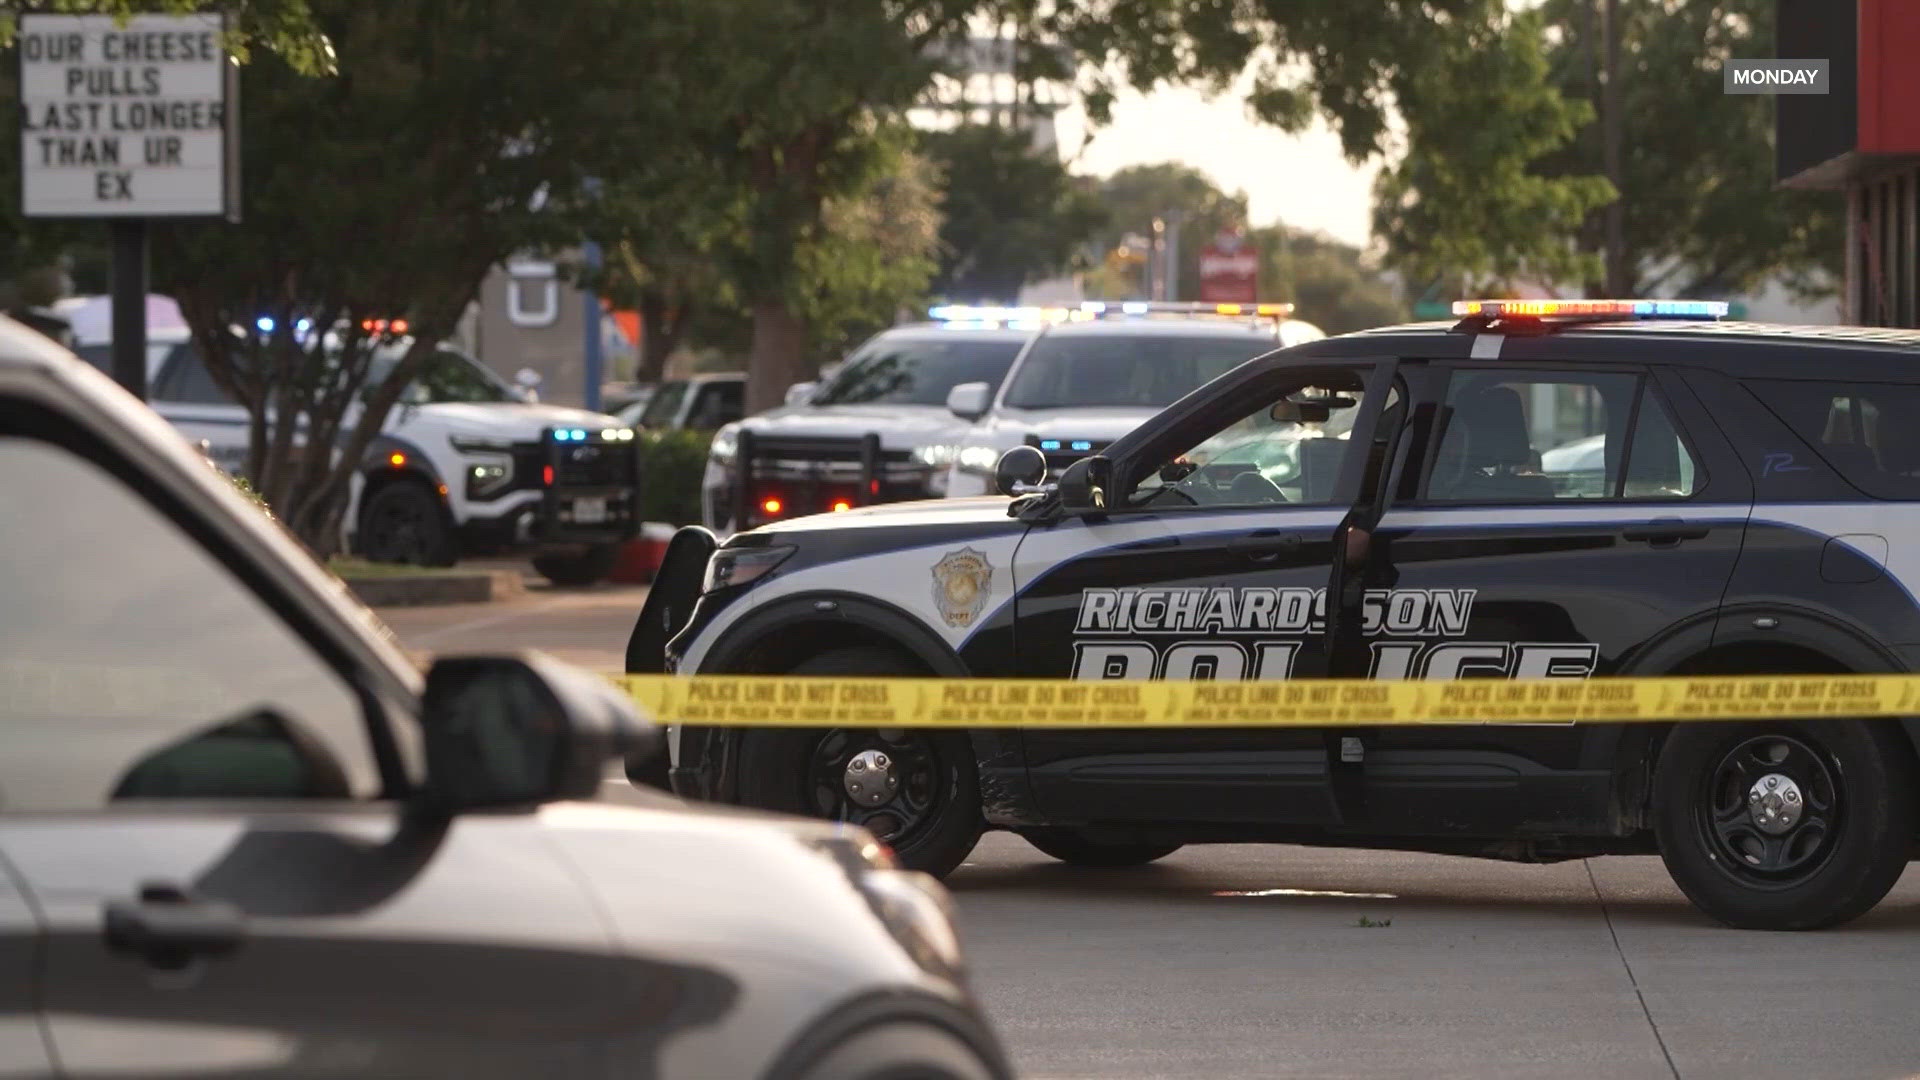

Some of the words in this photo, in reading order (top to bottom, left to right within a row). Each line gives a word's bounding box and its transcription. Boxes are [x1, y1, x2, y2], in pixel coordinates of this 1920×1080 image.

[24, 33, 84, 62] OUR
[103, 31, 214, 62] CHEESE
[66, 67, 160, 96] PULLS
[21, 102, 102, 131] LAST
[111, 102, 225, 131] LONGER
[38, 137, 119, 166] THAN
[144, 137, 182, 165] UR
[96, 171, 133, 201] EX
[1073, 587, 1477, 637] RICHARDSON
[688, 682, 738, 704] POLICE
[745, 682, 776, 704] LINE
[782, 682, 801, 704] DO
[807, 682, 835, 704] NOT
[840, 682, 889, 704] CROSS
[943, 685, 993, 704] POLICE
[998, 685, 1029, 704] LINE
[1035, 685, 1054, 704] DO
[1060, 685, 1088, 704] NOT
[1092, 685, 1140, 704] CROSS
[1193, 686, 1243, 704] POLICE
[1248, 686, 1280, 704] LINE
[1286, 686, 1304, 704] DO
[1309, 686, 1338, 704] NOT
[1341, 686, 1389, 704] CROSS
[1441, 684, 1491, 702] POLICE
[1495, 684, 1526, 702] LINE
[1532, 684, 1551, 702] DO
[1556, 684, 1585, 702] NOT
[1587, 684, 1635, 702] CROSS
[1686, 682, 1735, 699] POLICE
[1739, 682, 1770, 699] LINE
[1776, 682, 1794, 699] DO
[1799, 682, 1826, 699] NOT
[1829, 682, 1877, 699] CROSS
